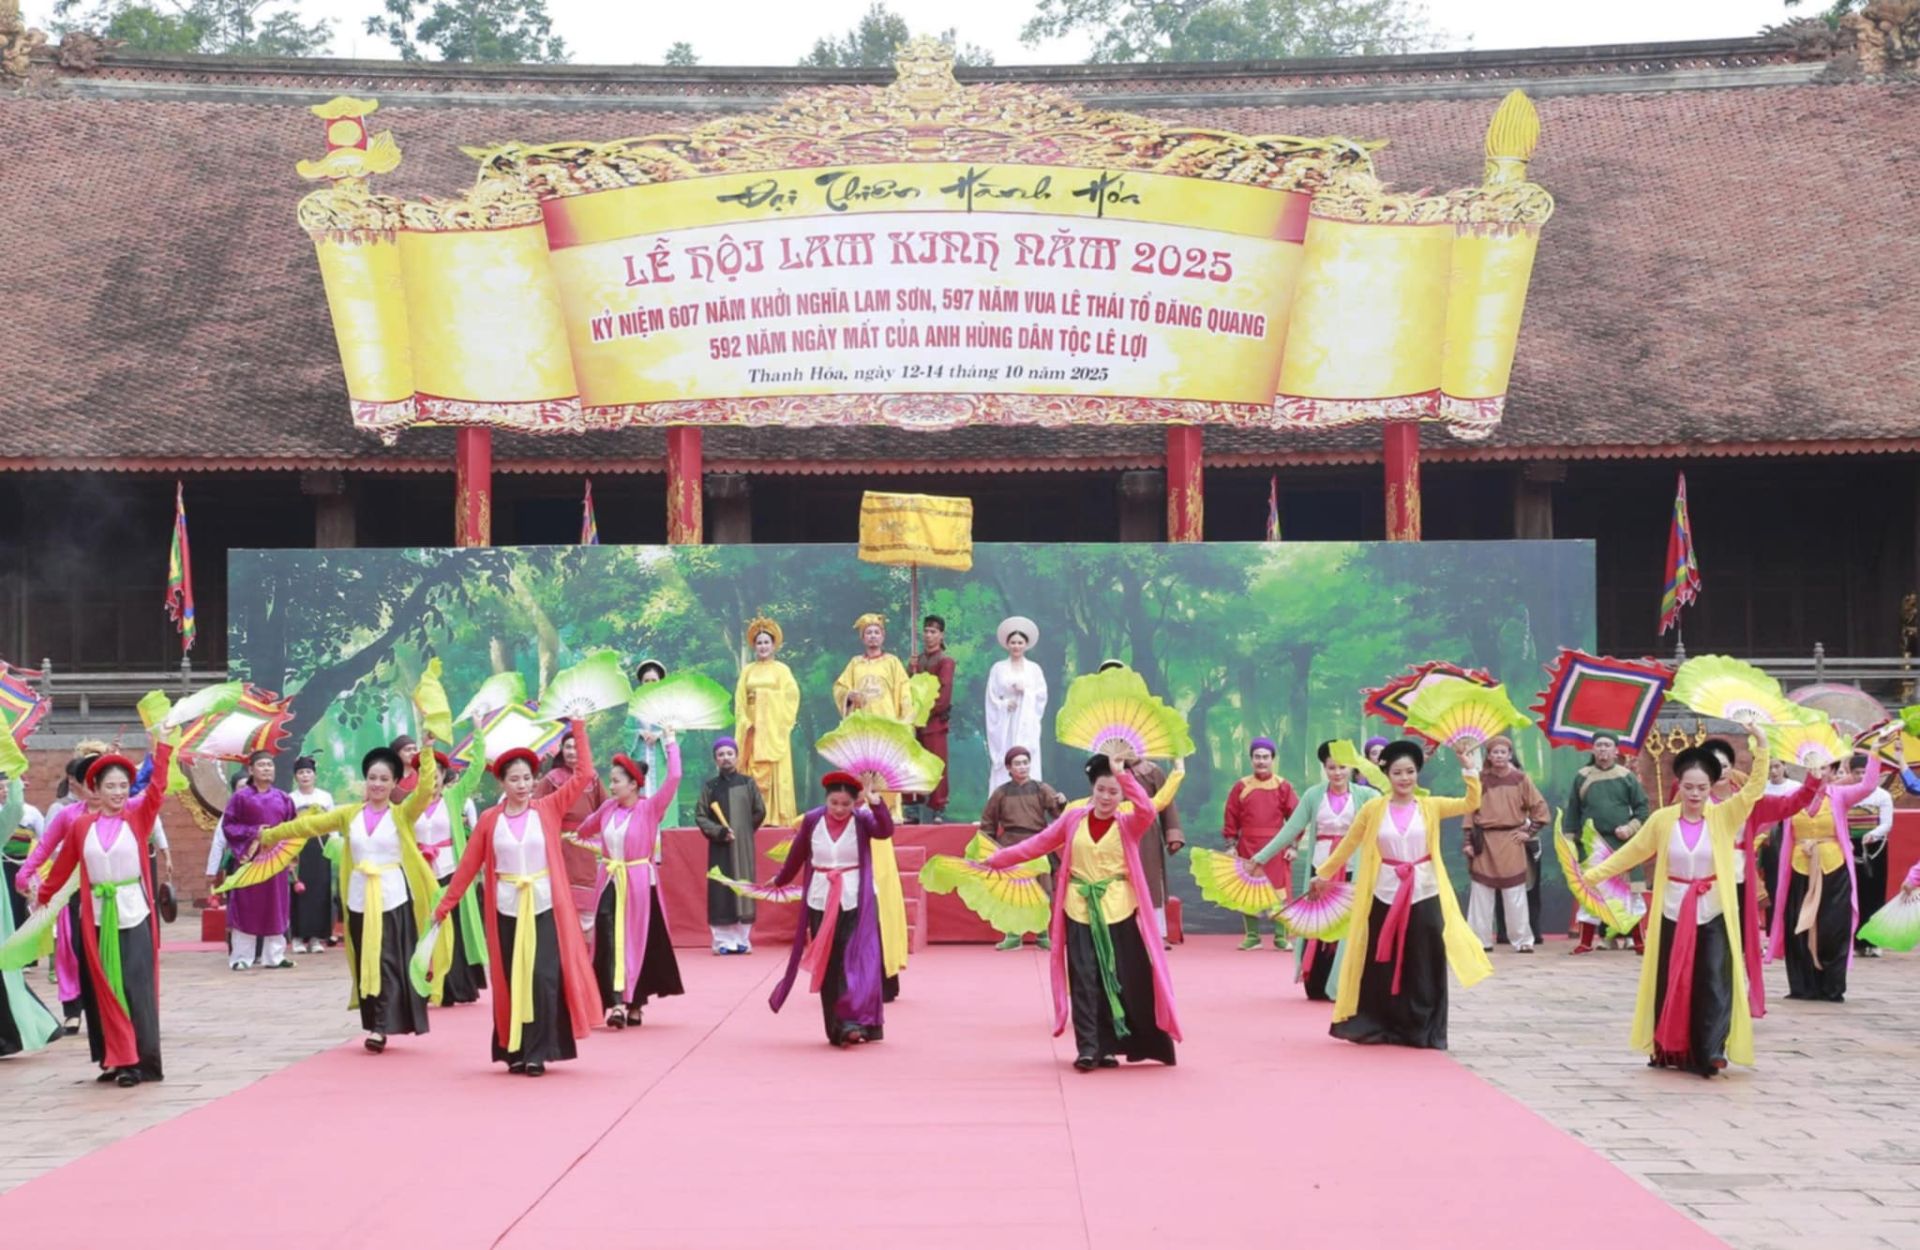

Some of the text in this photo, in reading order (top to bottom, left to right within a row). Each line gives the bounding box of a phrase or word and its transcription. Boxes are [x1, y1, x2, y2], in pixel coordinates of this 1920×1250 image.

[716, 179, 798, 211] Đại
[814, 171, 920, 212] Thiên
[623, 227, 1233, 287] LỄ HỘI LAM KINH NĂM 2025
[592, 286, 1266, 341] KỶ NIỆM 607 NĂM KHỞI NGHĨA LAM SƠN, 597 NĂM VUA LÊ THÁI TỔ ĐĂNG QUANG
[709, 318, 1148, 363] 592 NĂM NGÀY MẤT CỦA ANH HÙNG DÂN TỘC LÊ LỢI
[748, 367, 803, 384] Thanh
[854, 364, 896, 382] ngày
[901, 364, 944, 379] 12-14
[949, 363, 999, 381] tháng
[1005, 364, 1024, 379] 10
[1028, 366, 1066, 381] năm
[1070, 366, 1110, 382] 2025
